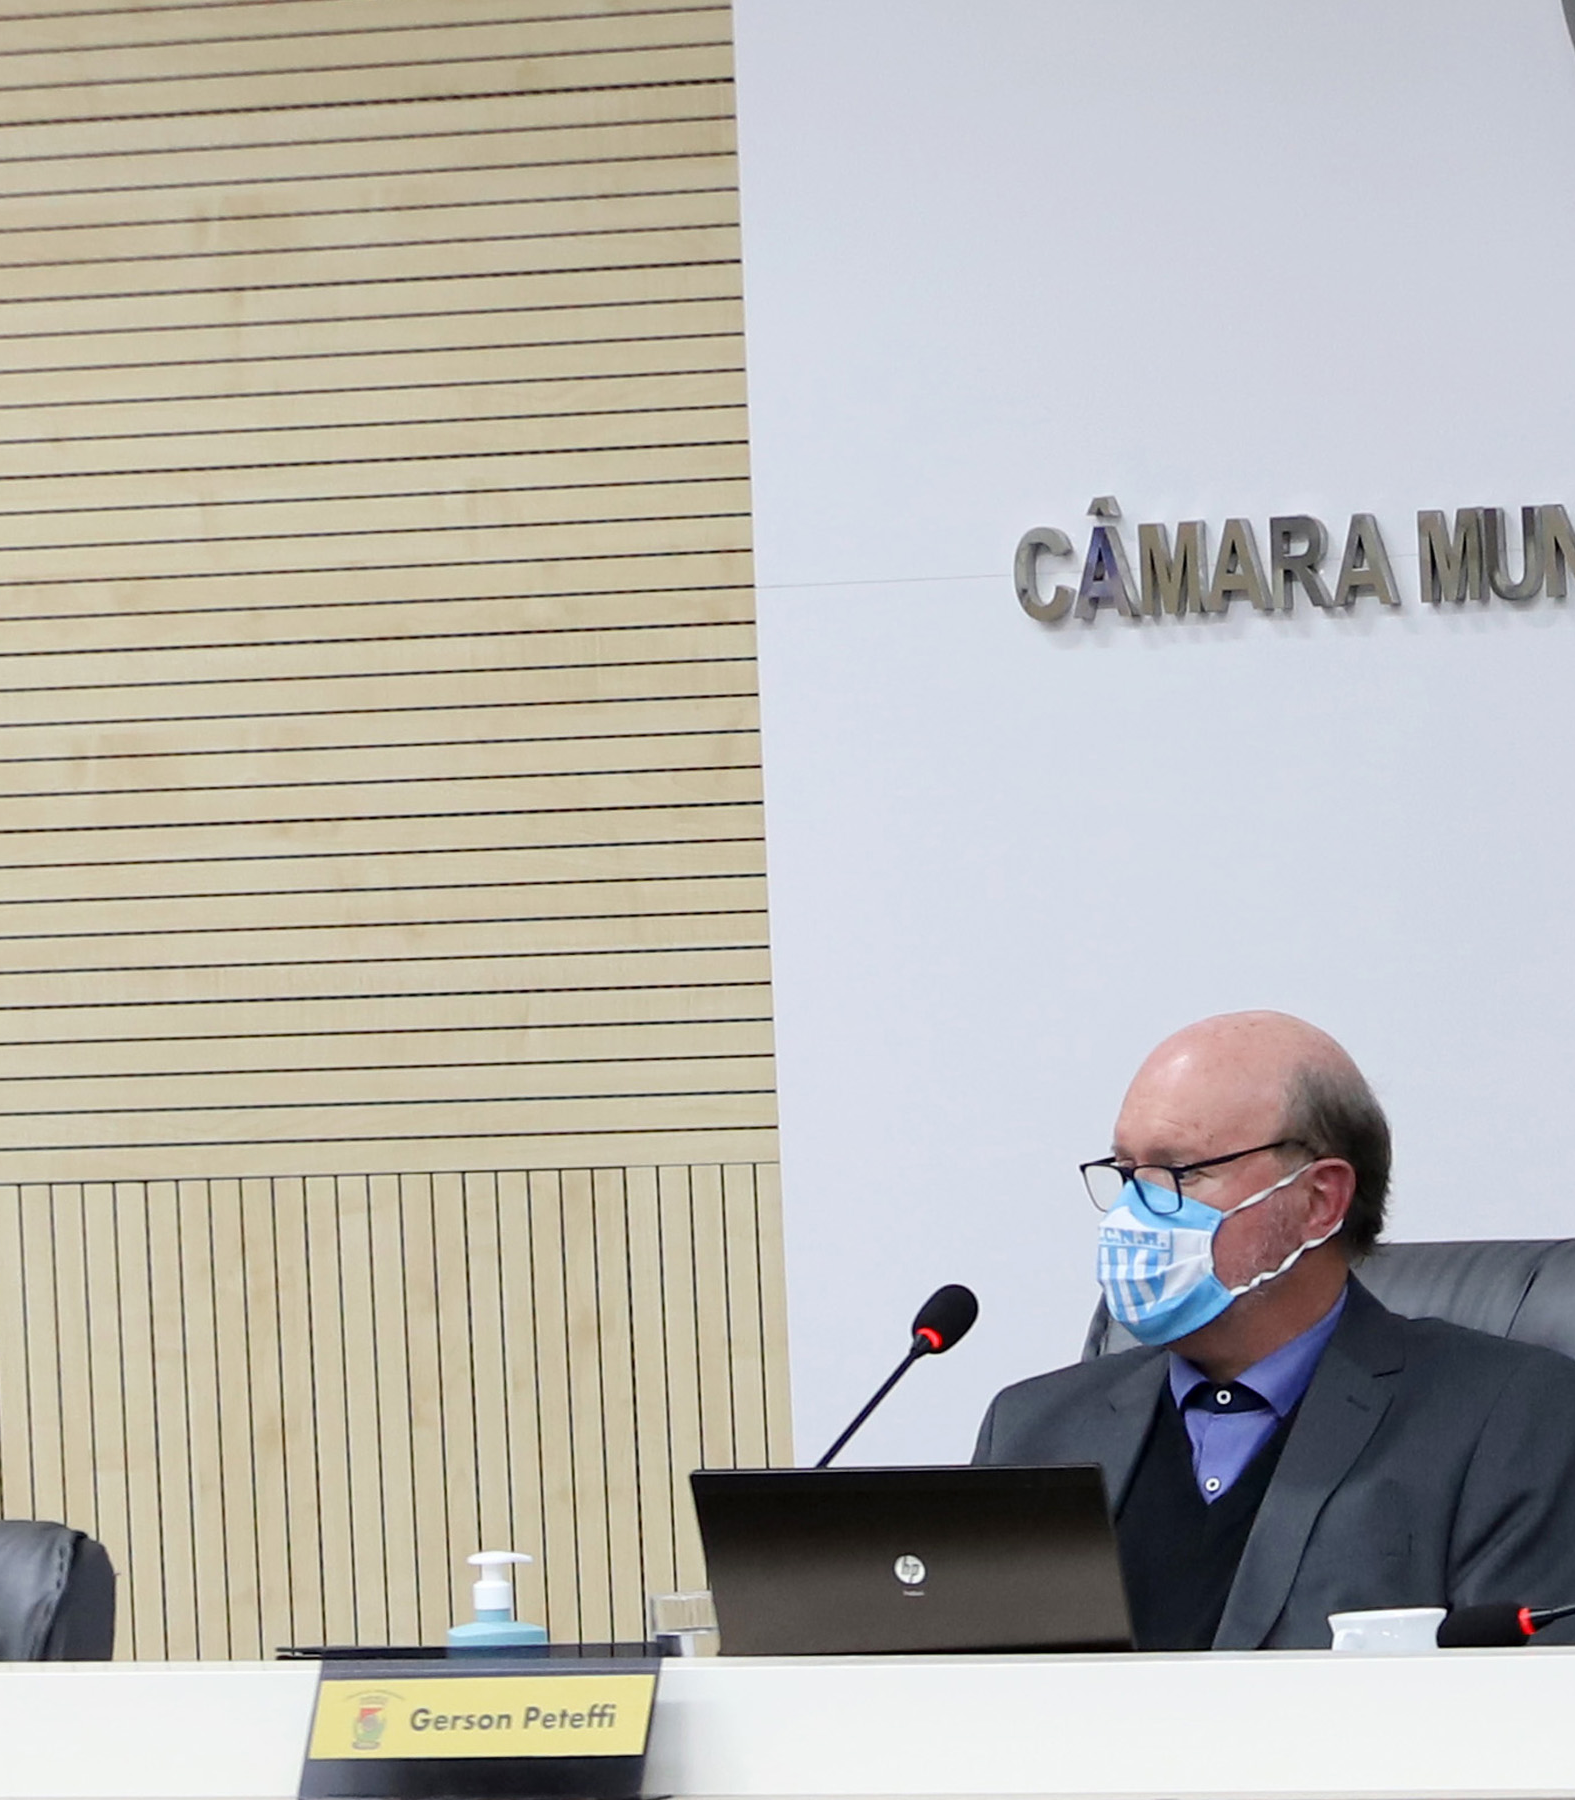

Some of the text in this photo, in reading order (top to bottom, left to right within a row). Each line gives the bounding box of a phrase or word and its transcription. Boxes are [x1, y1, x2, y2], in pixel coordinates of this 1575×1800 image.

[1013, 496, 1401, 622] CÂMARA
[409, 1703, 618, 1733] Gerson Peteffi
